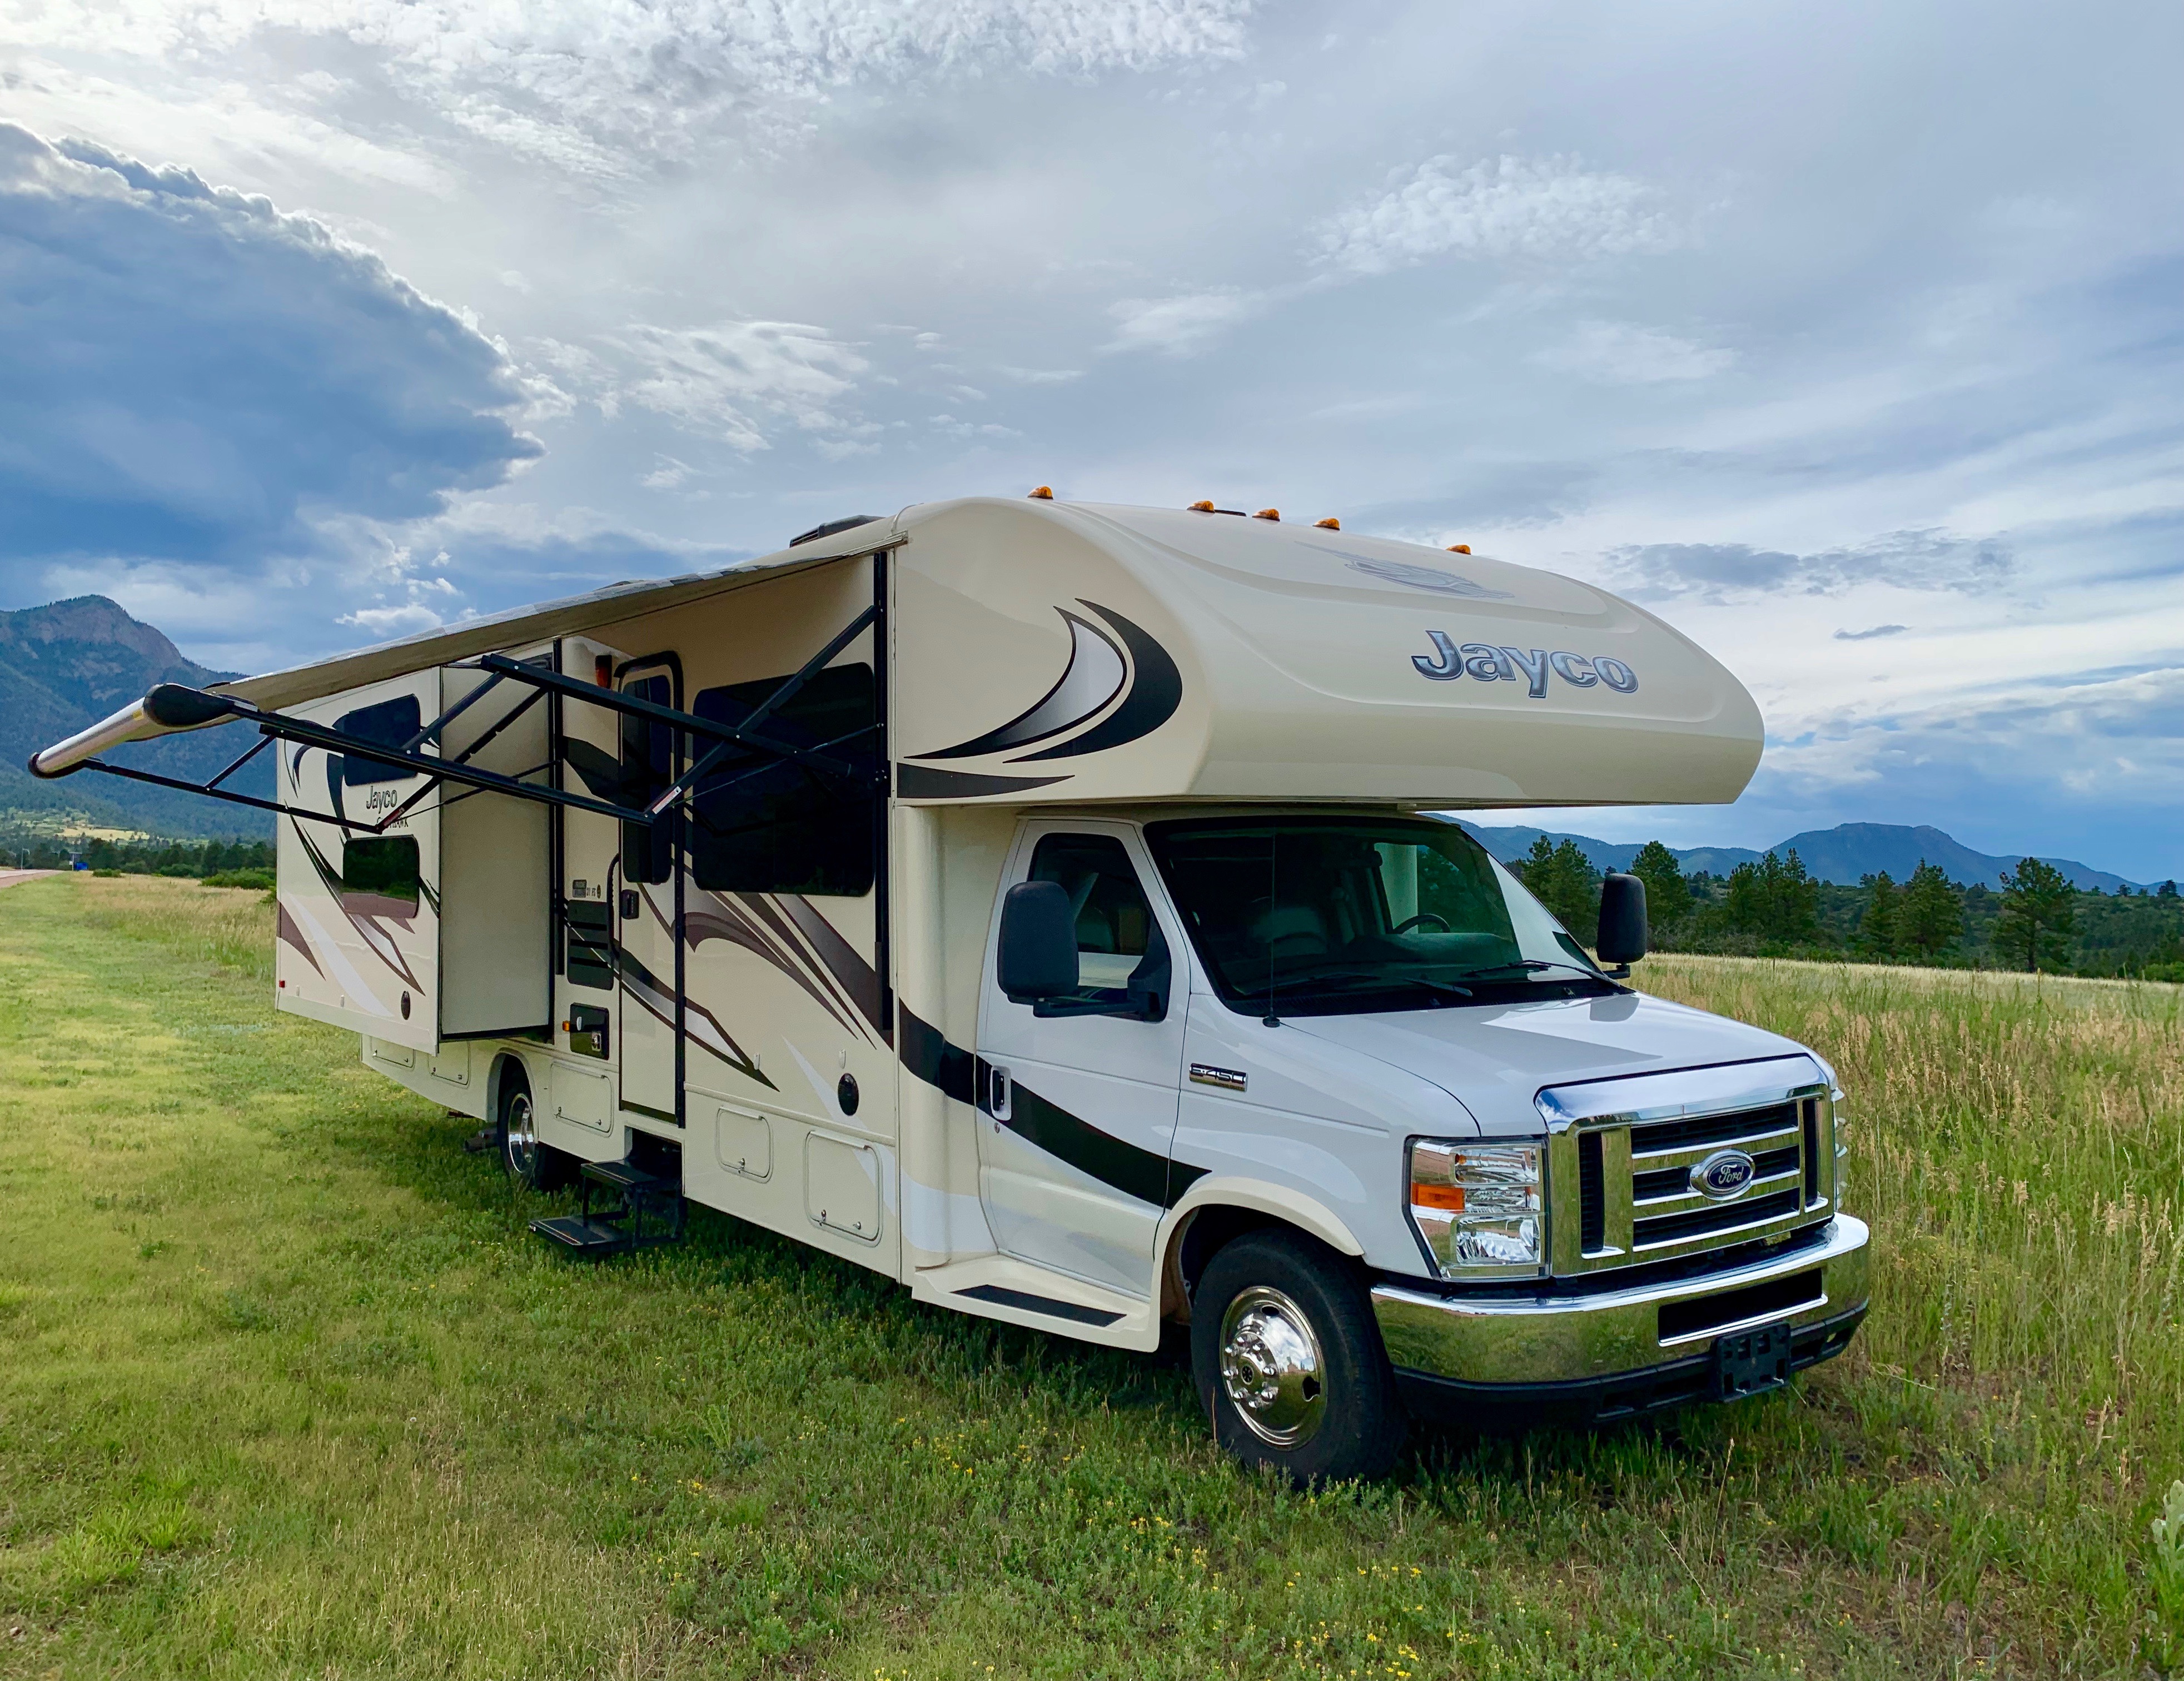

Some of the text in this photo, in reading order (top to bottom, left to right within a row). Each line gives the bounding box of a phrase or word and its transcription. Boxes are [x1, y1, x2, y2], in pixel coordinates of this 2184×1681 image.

[1411, 630, 1639, 698] Jayco
[366, 785, 397, 814] Jayco
[1719, 1164, 1744, 1185] Ford
